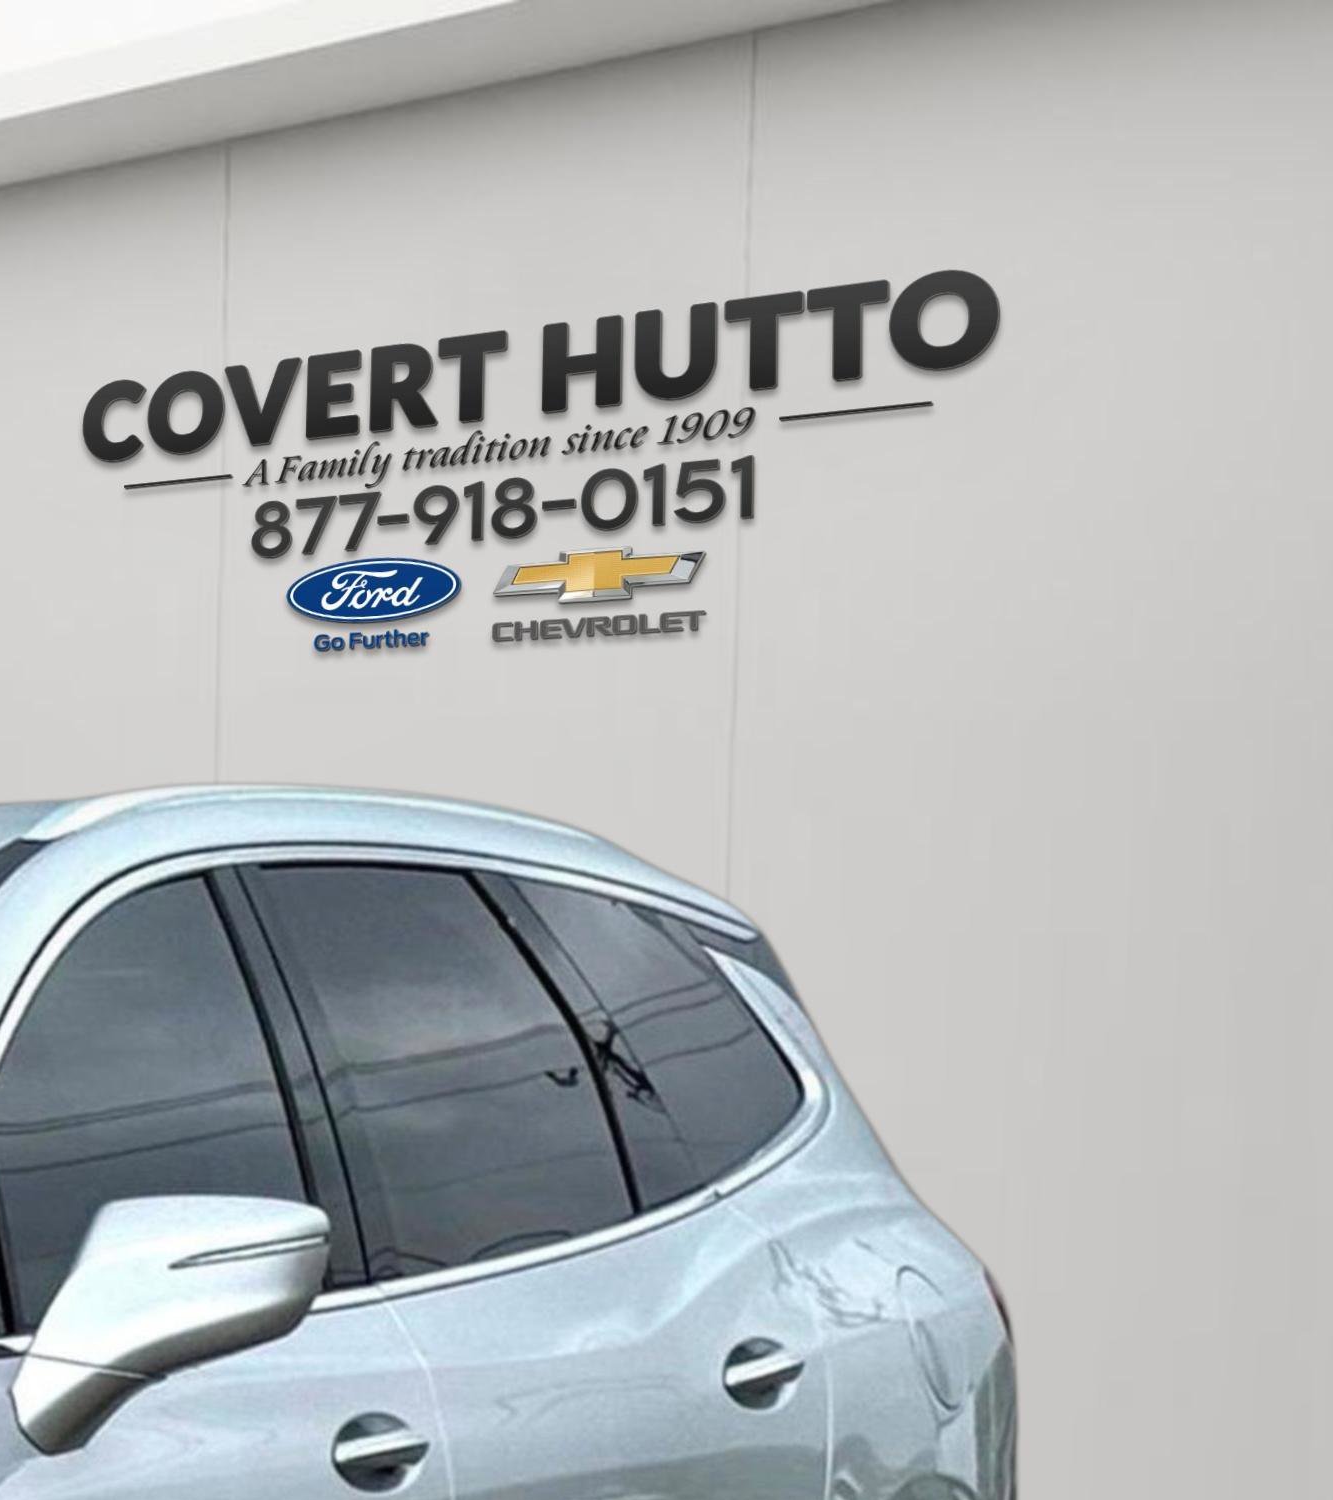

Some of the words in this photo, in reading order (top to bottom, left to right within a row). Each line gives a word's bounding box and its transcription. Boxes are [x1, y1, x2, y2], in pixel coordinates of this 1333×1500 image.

[81, 330, 509, 465] COVERT
[541, 268, 1002, 416] HUTTO
[241, 457, 269, 489] A
[275, 440, 392, 489] Family
[402, 429, 551, 473] tradition
[561, 424, 649, 456] since
[656, 406, 757, 447] 1909
[250, 454, 756, 561] 877-918-0151
[320, 569, 421, 611] Ford
[313, 632, 346, 653] Go
[348, 627, 431, 651] Further
[491, 609, 708, 644] CHEVROLET
